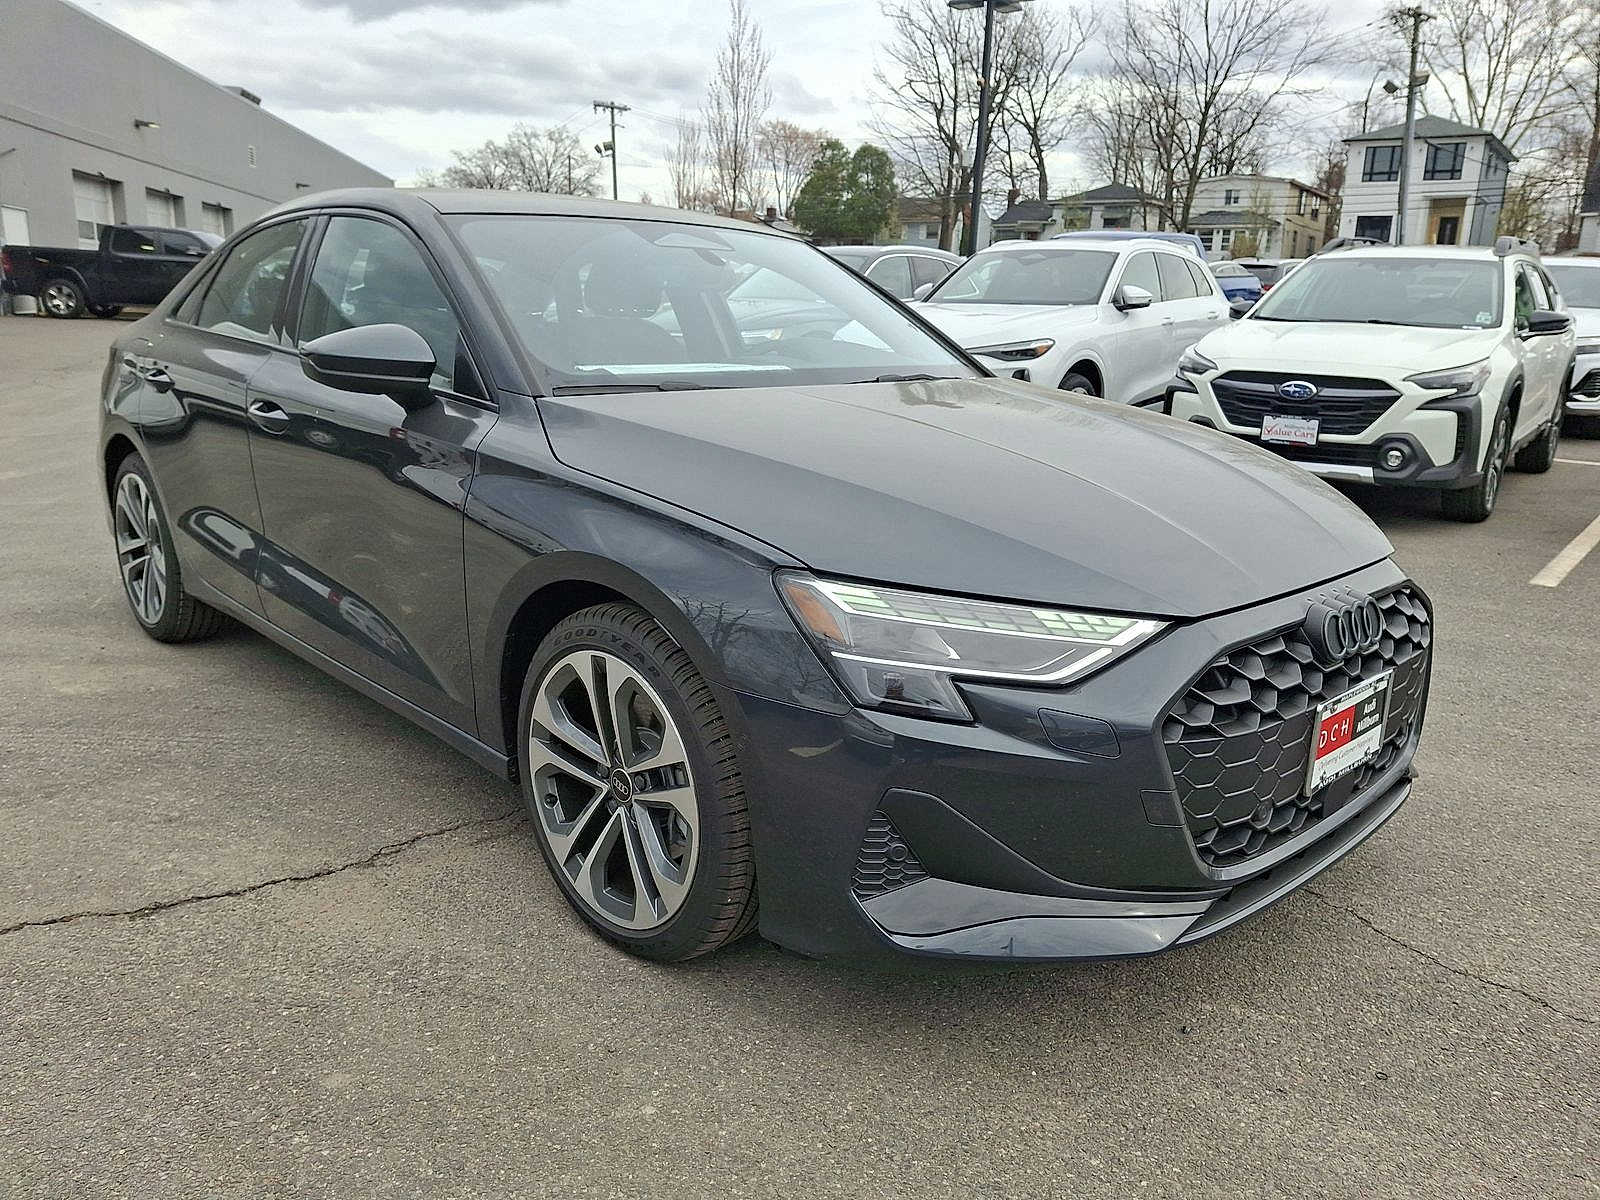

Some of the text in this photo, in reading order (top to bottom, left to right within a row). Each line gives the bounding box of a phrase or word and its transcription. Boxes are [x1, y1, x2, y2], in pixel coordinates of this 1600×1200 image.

[1294, 429, 1315, 438] Cars
[1363, 698, 1377, 715] Audi
[1318, 775, 1337, 789] AUDI
